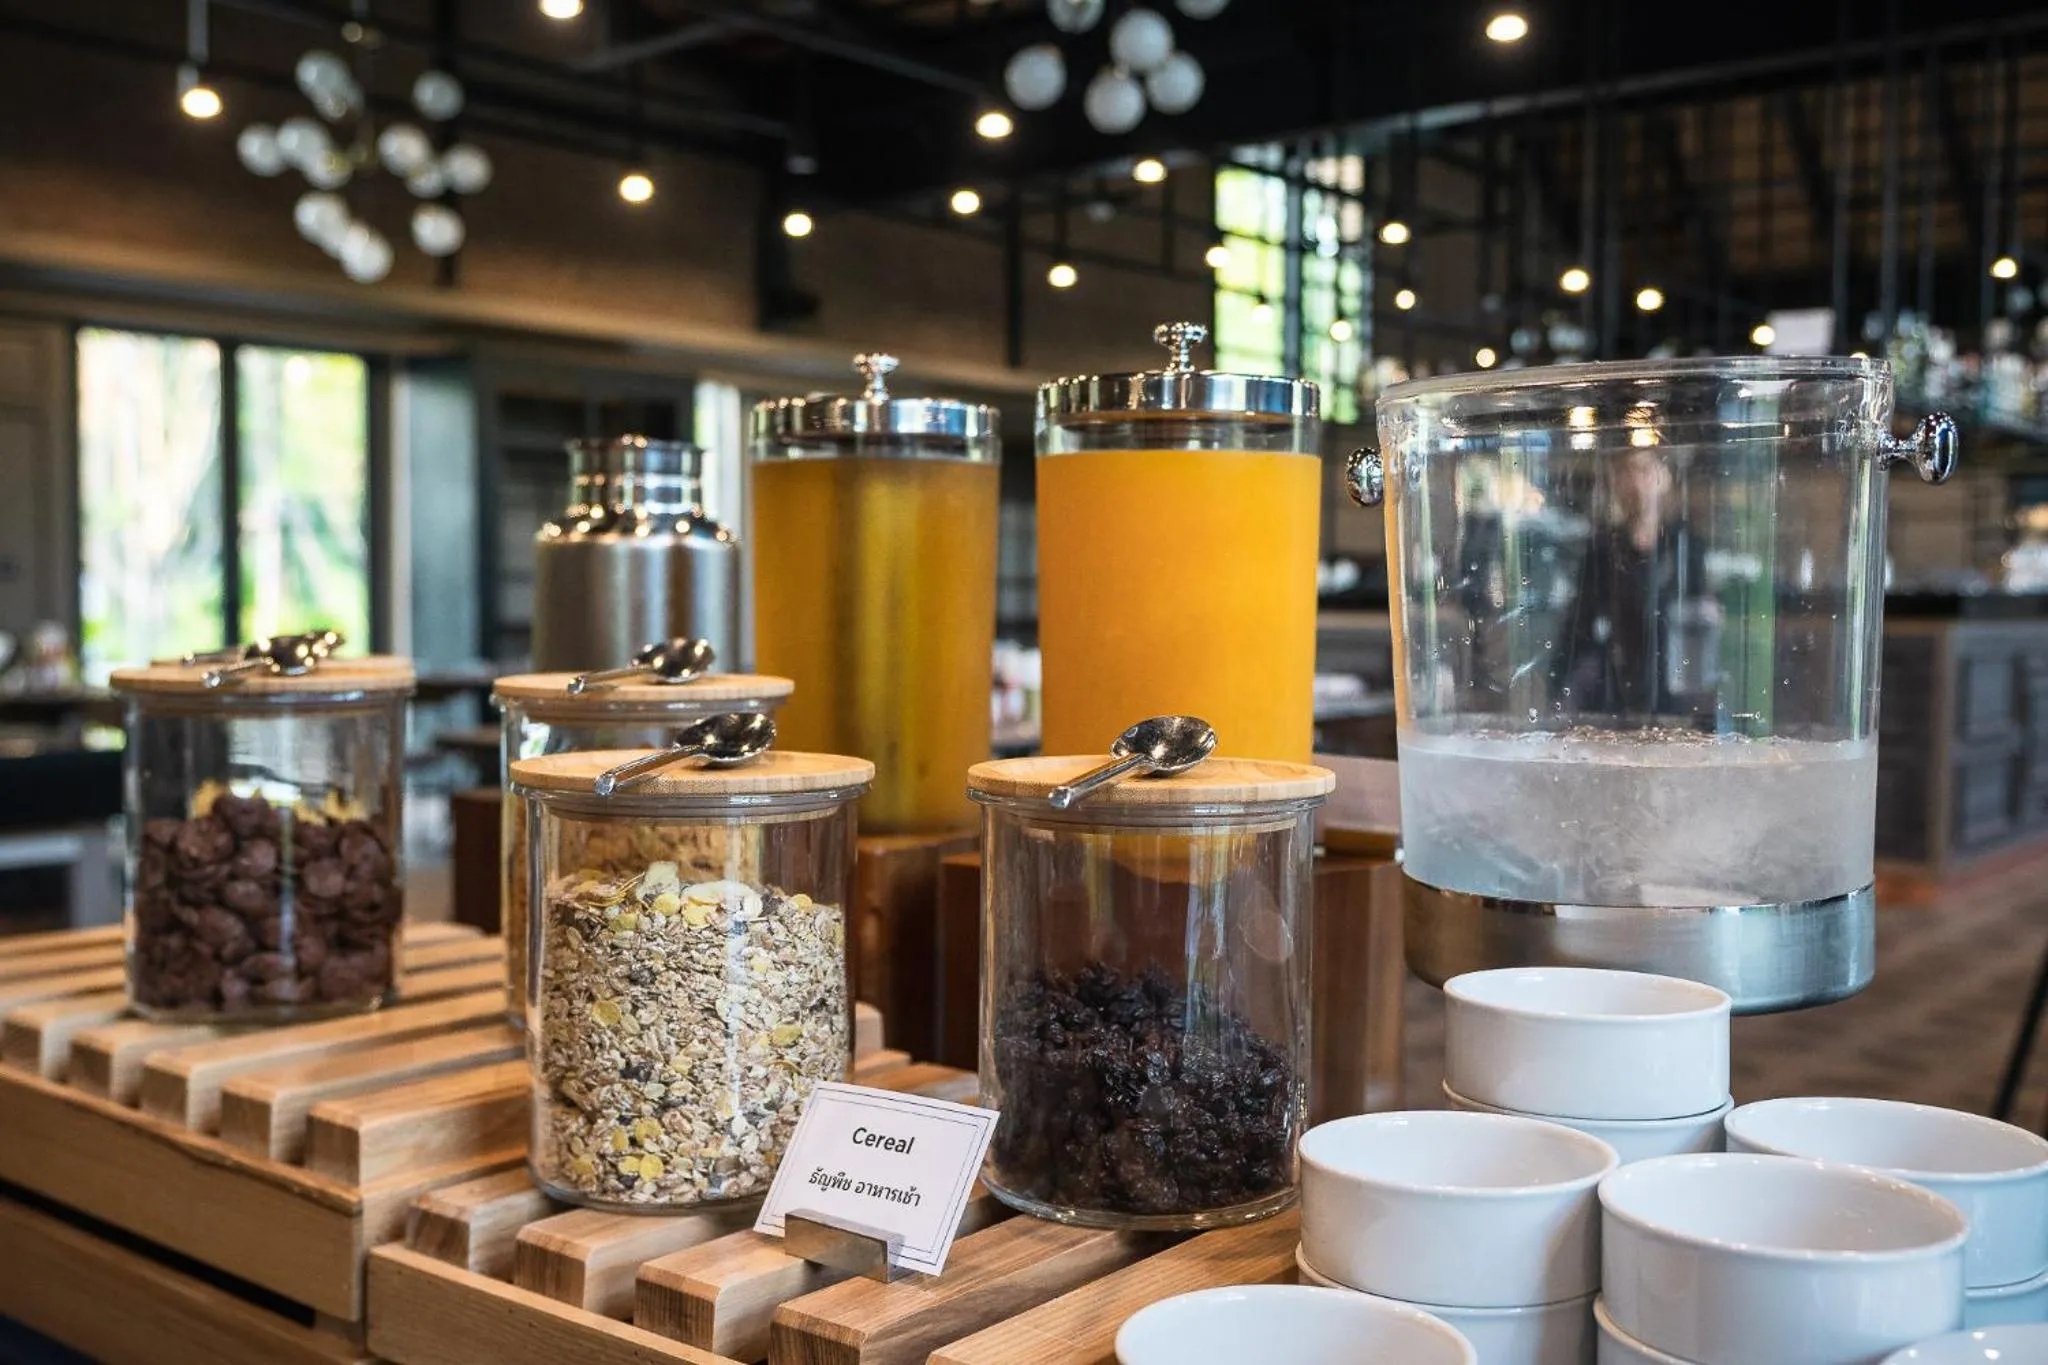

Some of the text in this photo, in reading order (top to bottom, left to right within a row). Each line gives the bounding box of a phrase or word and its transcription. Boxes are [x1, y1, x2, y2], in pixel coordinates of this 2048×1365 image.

[852, 1126, 916, 1155] Cereal
[854, 1181, 921, 1207] อาหารเช้า
